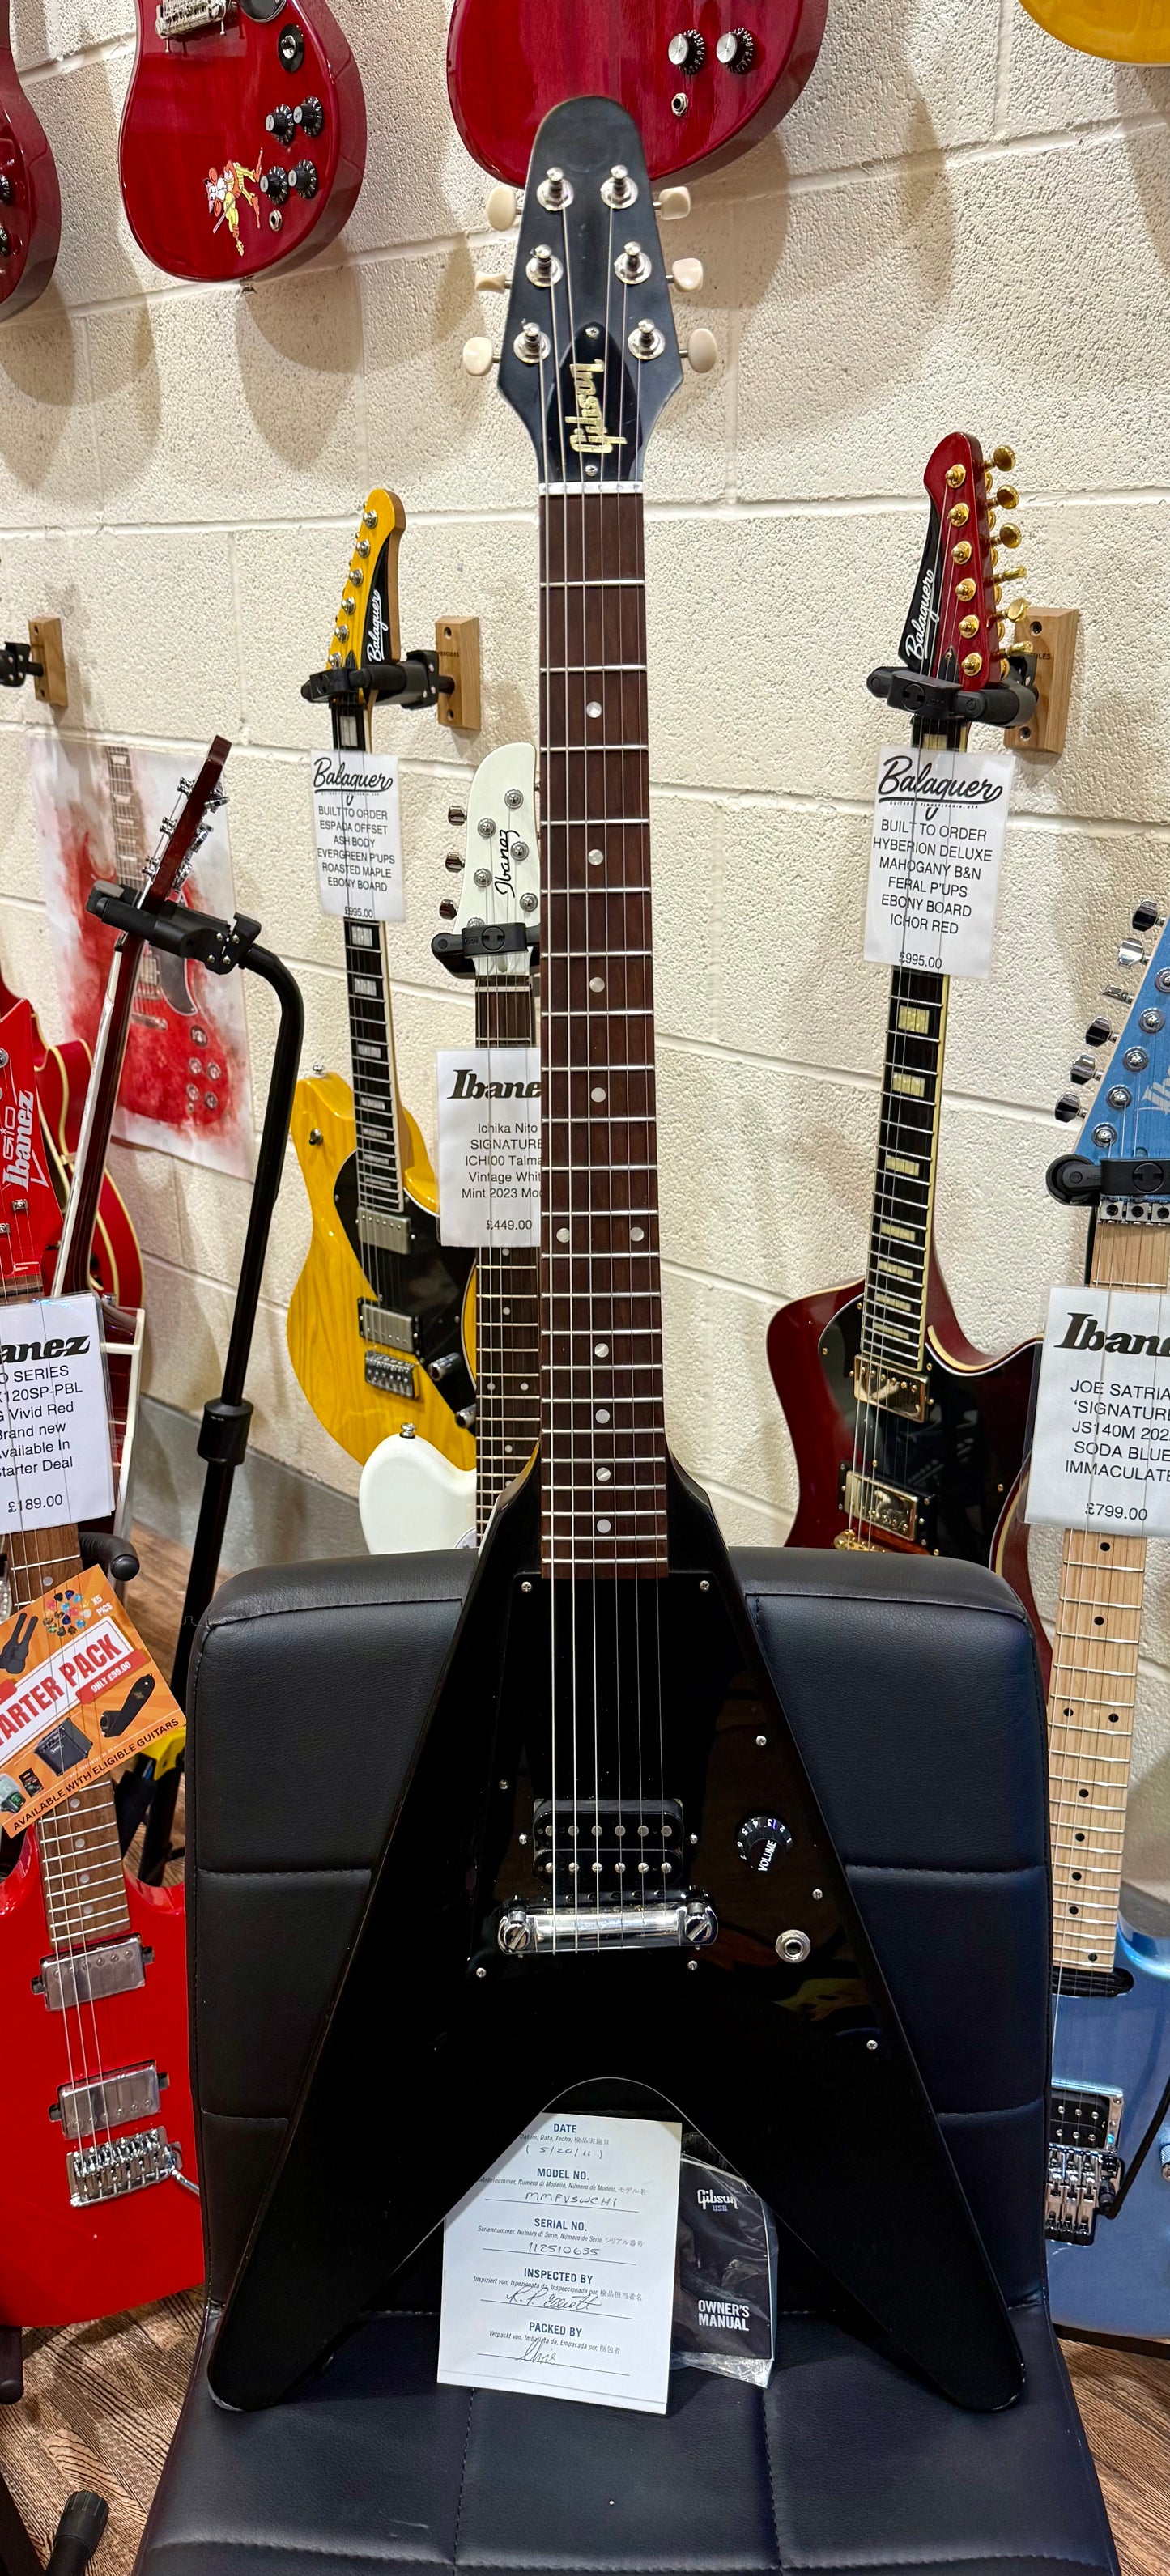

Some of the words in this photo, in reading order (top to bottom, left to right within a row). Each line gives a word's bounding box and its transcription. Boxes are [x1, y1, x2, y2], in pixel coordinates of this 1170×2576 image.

[564, 359, 628, 453] Gibson
[905, 569, 939, 660] Balaguer
[367, 589, 389, 661] Balaguer
[313, 757, 393, 806] Balaguer
[878, 755, 1003, 821] Balaguer
[318, 806, 341, 816] BUILT
[343, 807, 355, 818] TO
[356, 809, 388, 820] ORDER
[320, 820, 353, 832] ESPADA
[355, 823, 388, 835] OFFSET
[881, 818, 917, 833] BUILT
[920, 823, 936, 836] TO
[939, 825, 986, 842] ORDER
[334, 835, 350, 845] ASH
[352, 837, 376, 848] BODY
[873, 837, 936, 856] HYBERION
[939, 844, 993, 861] DELUXE
[317, 848, 368, 861] EVERGREEN
[369, 852, 395, 864] P'UPS
[495, 829, 521, 898] Ibanez
[322, 862, 360, 875] ROASTED
[362, 866, 392, 878] MAPLE
[879, 857, 951, 876] MAHOGANY
[955, 865, 981, 880] B&N
[328, 877, 355, 888] EBONY
[357, 880, 388, 892] BOARD
[888, 876, 926, 893] FERAL
[930, 882, 968, 898] P'UPS
[882, 894, 923, 911] EBONY
[926, 900, 972, 917] BOARD
[891, 913, 928, 930] ICHOR
[932, 920, 959, 934] RED
[899, 951, 942, 969] £995.00
[447, 1069, 542, 1099] Ibane
[478, 1122, 511, 1133] Ichika
[515, 1122, 538, 1133] Nito
[2, 1090, 34, 1192] Ibanez
[469, 1171, 512, 1184] Vintage
[462, 1188, 486, 1198] Mint
[490, 1188, 517, 1199] 2023
[486, 1219, 532, 1231] £449.00
[14, 1365, 70, 1383] SERIES
[1070, 1379, 1104, 1395] JOE
[9, 1405, 42, 1420] Vivid
[47, 1401, 74, 1415] Red
[39, 1422, 66, 1435] new
[1072, 1420, 1135, 1439] JS140M
[1141, 1426, 1170, 1442] 202
[0, 1441, 53, 1458] vailable
[58, 1439, 70, 1452] In
[1074, 1440, 1123, 1458] SODA
[1128, 1447, 1170, 1462] BLUE
[0, 1464, 39, 1477] tarter
[43, 1456, 74, 1473] Deal
[8, 1494, 63, 1513] £189.00
[1085, 1503, 1147, 1521] £799.00
[96, 1602, 113, 1617] PICS
[91, 1677, 109, 1693] ONLY
[107, 1660, 131, 1681] £99.00
[0, 1676, 65, 1746] ARTER
[59, 1634, 122, 1690] PACK
[13, 1789, 66, 1831] AVAILABLE
[66, 1770, 92, 1793] WITH
[92, 1744, 136, 1774] ELIGIBLE
[136, 1717, 179, 1747] GUITARS
[758, 1839, 777, 1872] VOLUME
[554, 2123, 577, 2133] DATE
[537, 2168, 570, 2179] MODEL
[573, 2170, 589, 2181] NO.
[697, 2189, 739, 2210] Gibson
[534, 2218, 568, 2230] SERIAL
[571, 2221, 587, 2232] NO.
[524, 2268, 576, 2283] INSPECTED
[581, 2274, 594, 2285] BY
[698, 2299, 750, 2318] OWNER'S
[529, 2322, 566, 2336] PACKED
[569, 2327, 582, 2338] BY
[698, 2312, 750, 2332] MANUAL
[489, 2330, 512, 2340] Verpackt
[559, 2339, 588, 2349] Empacada
